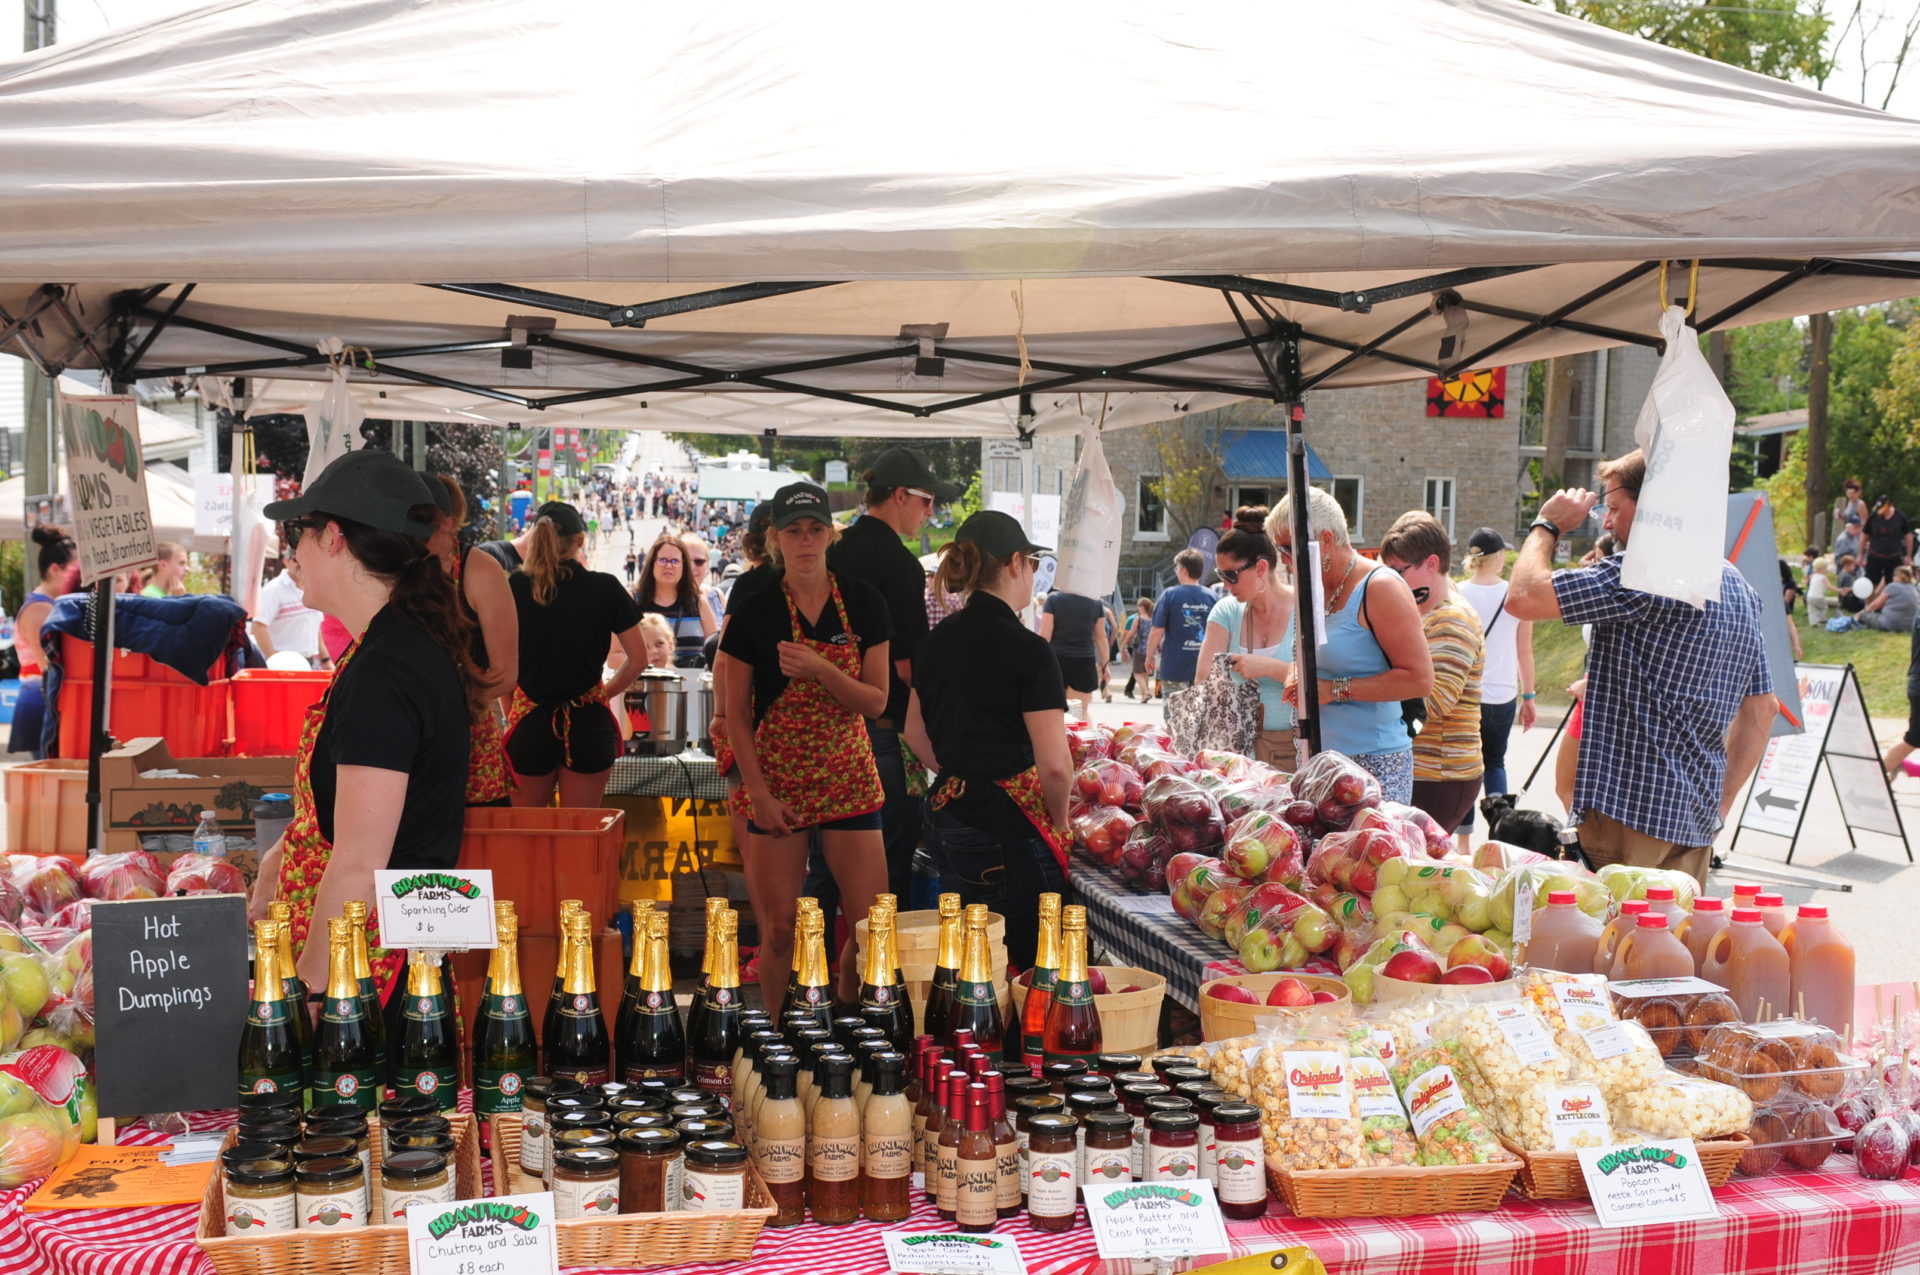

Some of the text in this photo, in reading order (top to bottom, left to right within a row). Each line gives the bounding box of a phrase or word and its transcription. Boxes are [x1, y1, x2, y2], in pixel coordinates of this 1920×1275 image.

[111, 536, 152, 562] Brantford
[391, 873, 481, 899] BRANTWOOD
[418, 890, 451, 900] FARMS
[401, 903, 471, 917] Sparkling Cider
[144, 915, 181, 940] Hot
[130, 950, 191, 980] Apple
[119, 986, 212, 1013] Dumplings
[696, 1075, 722, 1085] Crimson
[1290, 1064, 1343, 1090] Original
[1354, 1070, 1390, 1091] riginal
[501, 1096, 520, 1104] Apple
[1411, 1074, 1453, 1115] Original
[1556, 1112, 1601, 1121] KETTLECORN
[770, 1154, 791, 1163] FARMS
[824, 1153, 846, 1161] FARMS
[881, 1150, 902, 1158] FARMS
[1625, 1164, 1659, 1175] FARMS
[969, 1185, 993, 1193] FARMS
[1620, 1177, 1661, 1188] Popcorn
[1103, 1184, 1203, 1210] BRANTWOOD
[1635, 1188, 1656, 1197] Corn
[1134, 1200, 1171, 1210] FARMS
[1611, 1202, 1645, 1212] Caramel
[1646, 1198, 1664, 1207] Corn
[428, 1202, 540, 1241] BRANTWOOD
[1105, 1211, 1200, 1225] Apple Butter and
[462, 1224, 503, 1239] FARMS
[1108, 1224, 1193, 1238] Crab Apple Jelly
[429, 1233, 538, 1259] Chutney and Salsa
[1172, 1237, 1194, 1245] each
[479, 1261, 505, 1273] each
